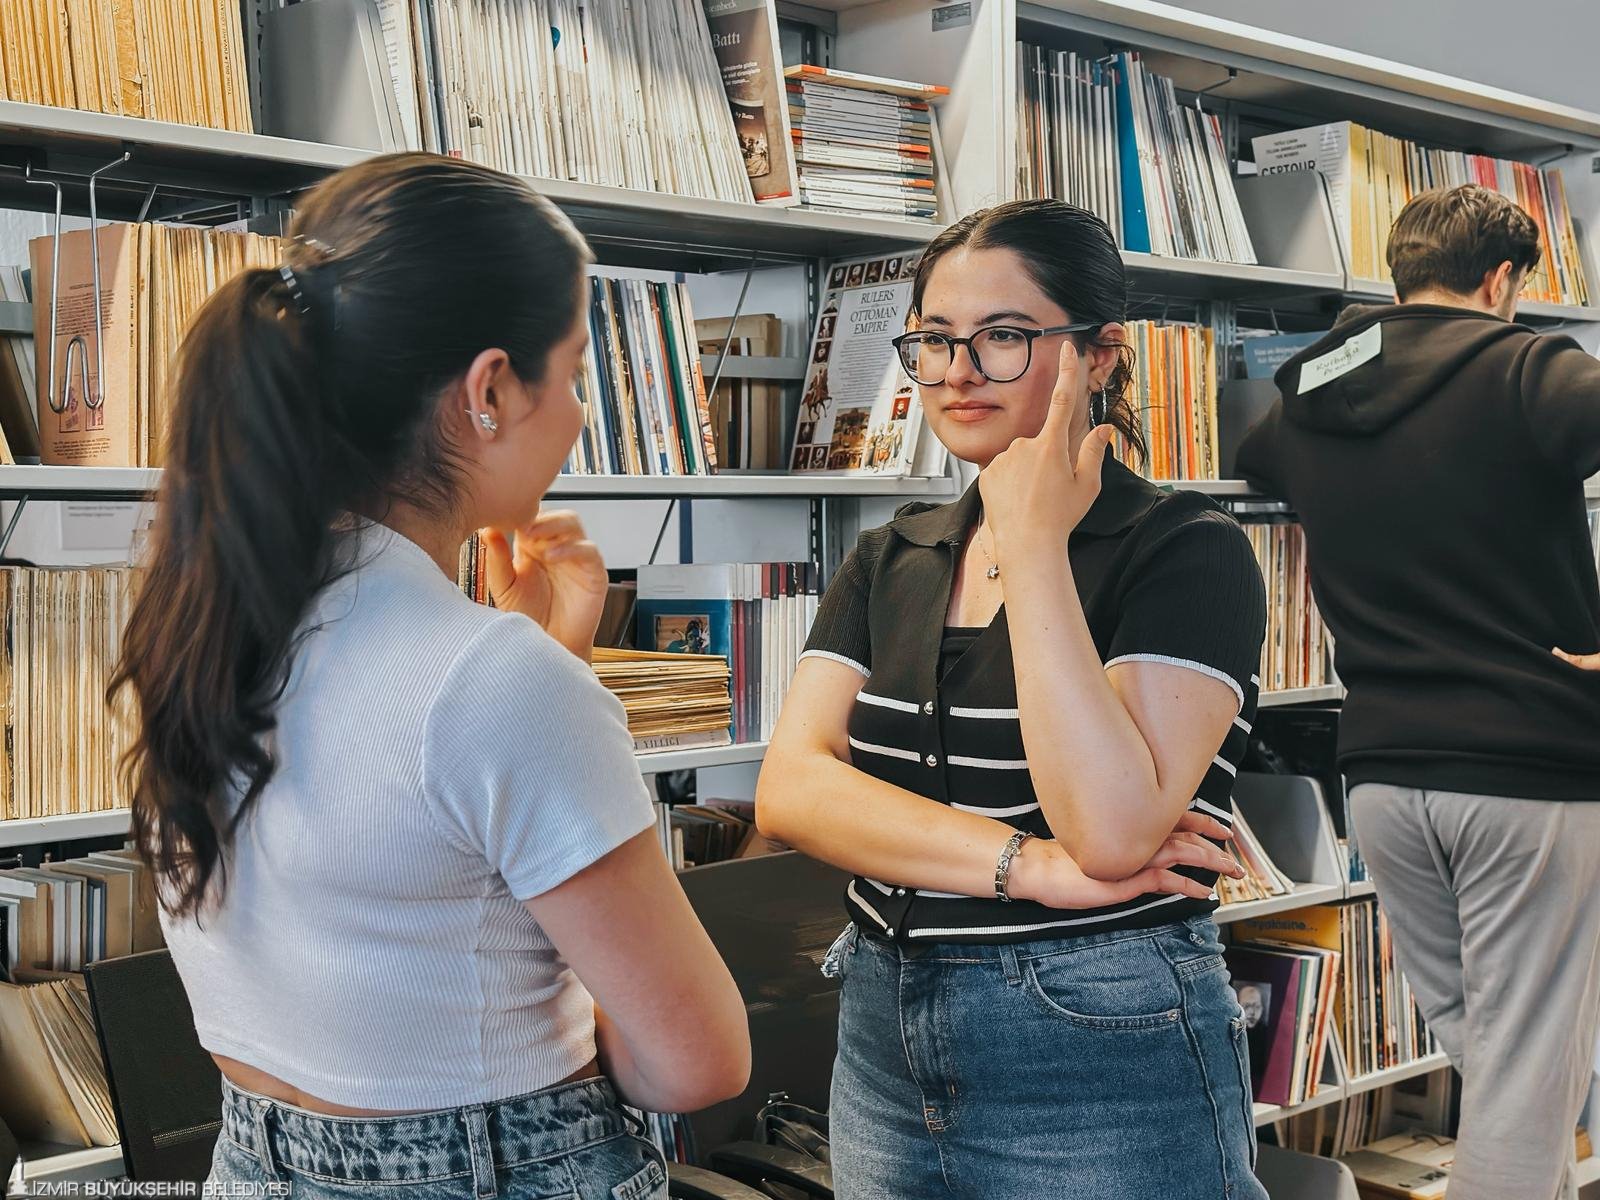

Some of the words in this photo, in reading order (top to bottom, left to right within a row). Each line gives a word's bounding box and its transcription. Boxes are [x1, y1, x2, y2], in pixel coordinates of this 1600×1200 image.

[861, 289, 895, 304] RULERS
[850, 306, 897, 323] OTTOMAN
[853, 320, 889, 335] EMPIRE
